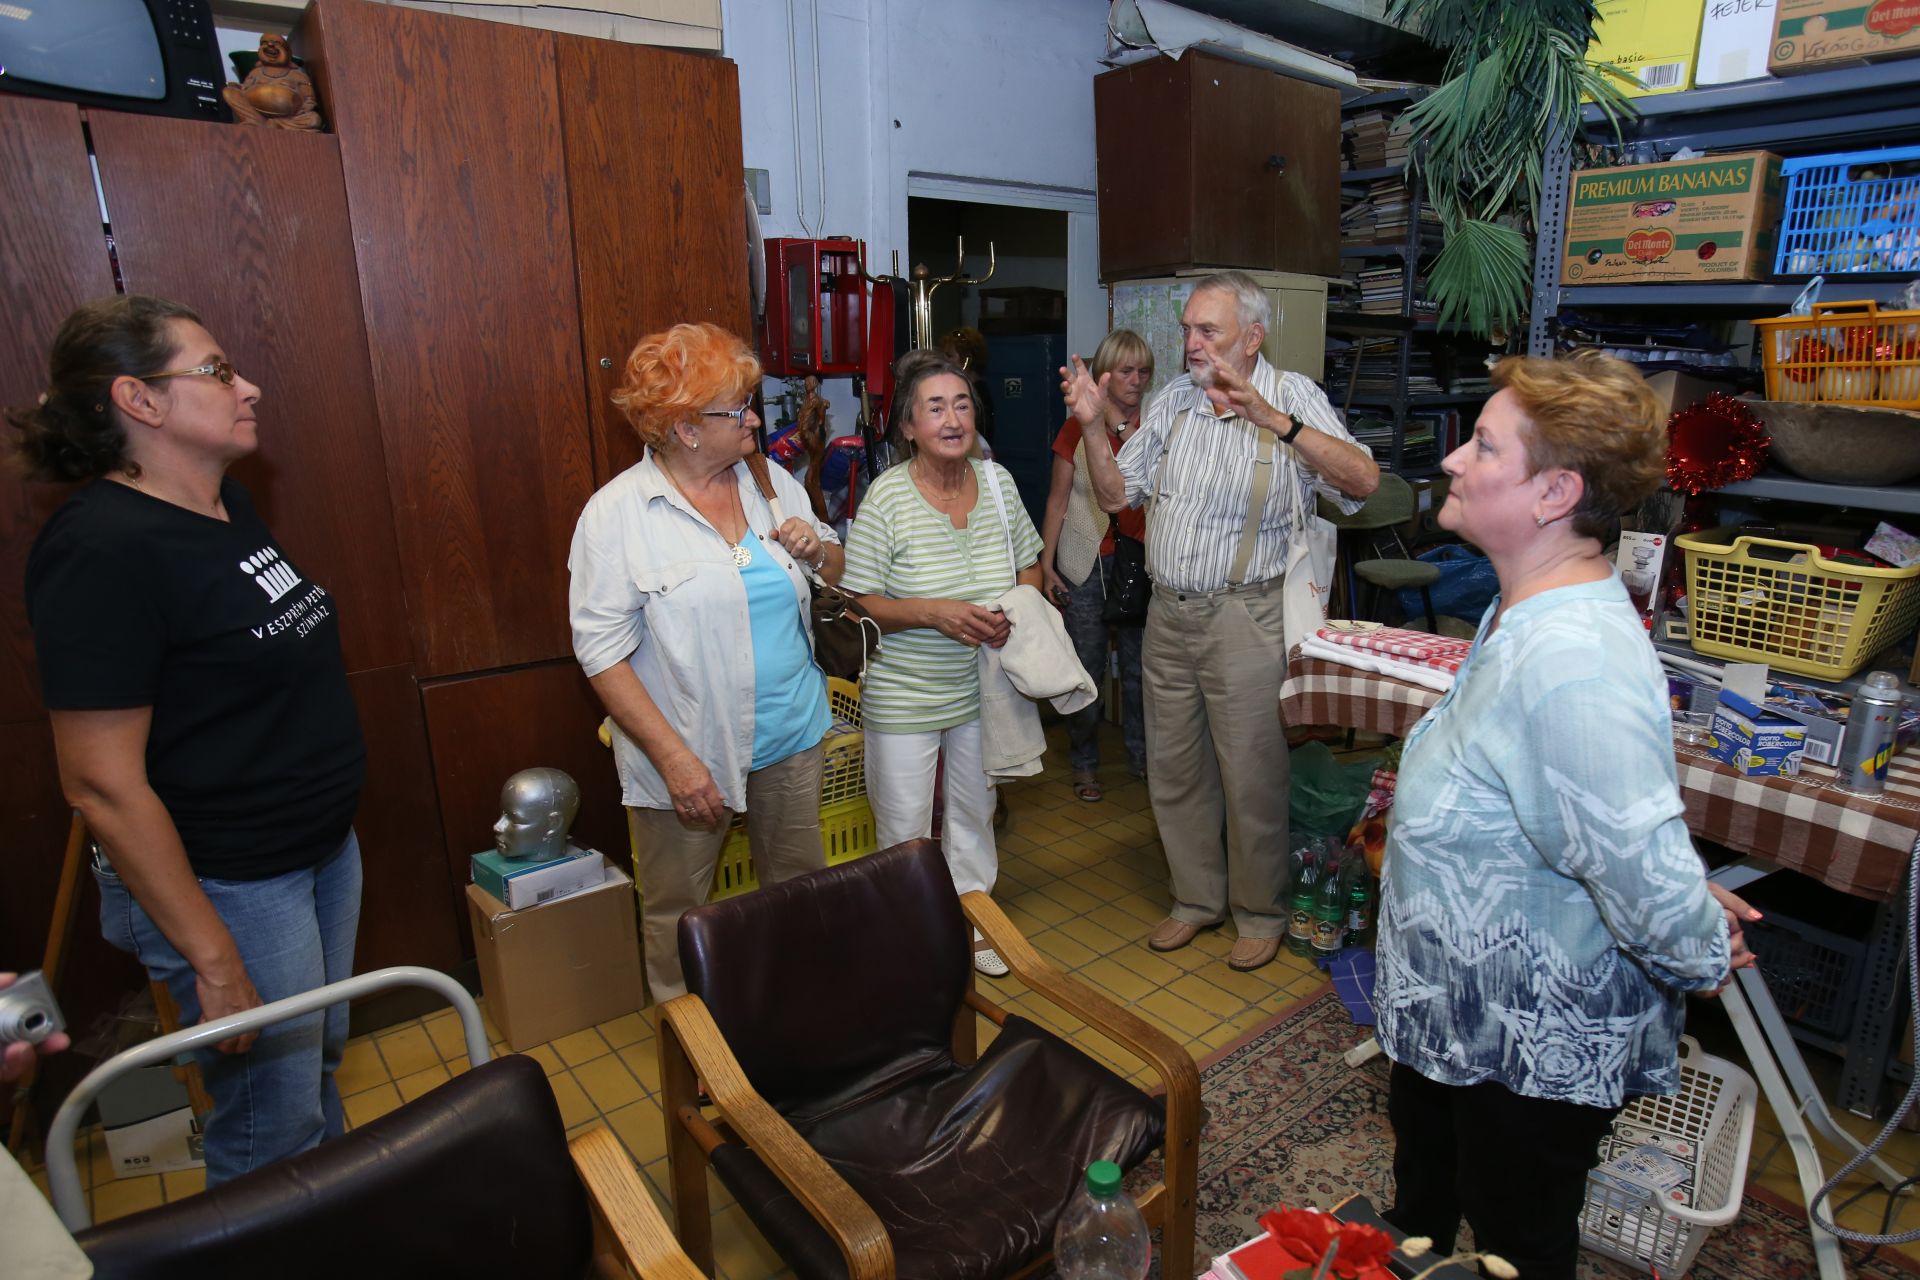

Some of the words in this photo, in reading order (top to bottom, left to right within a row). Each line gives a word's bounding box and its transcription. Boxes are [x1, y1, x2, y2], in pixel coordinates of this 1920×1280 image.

[1579, 176, 1654, 200] PREMIUM
[1658, 166, 1747, 192] BANANAS
[1628, 239, 1642, 250] Del
[1643, 239, 1670, 249] Monte
[296, 605, 330, 638] SZÍNHÁZ
[1715, 716, 1733, 729] GIOTTO
[1714, 723, 1751, 746] ROBERCOLOR
